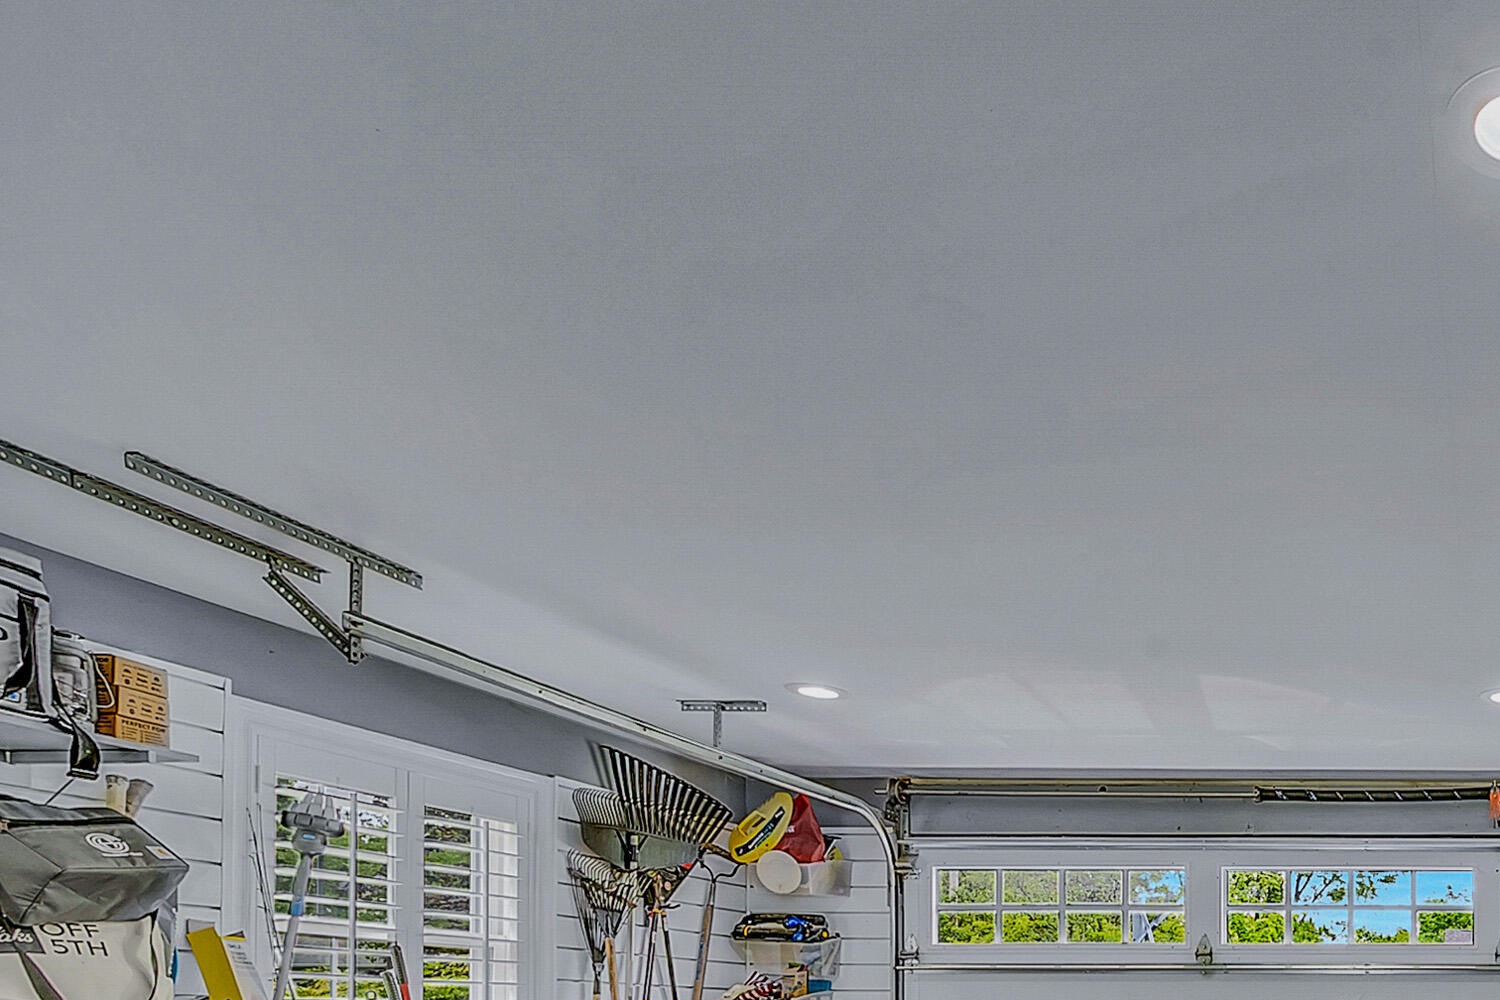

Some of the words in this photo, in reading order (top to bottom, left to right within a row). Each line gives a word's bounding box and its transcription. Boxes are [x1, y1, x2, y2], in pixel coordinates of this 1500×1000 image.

[0, 926, 33, 943] aks
[39, 921, 100, 938] OFF
[50, 939, 108, 957] 5TH
